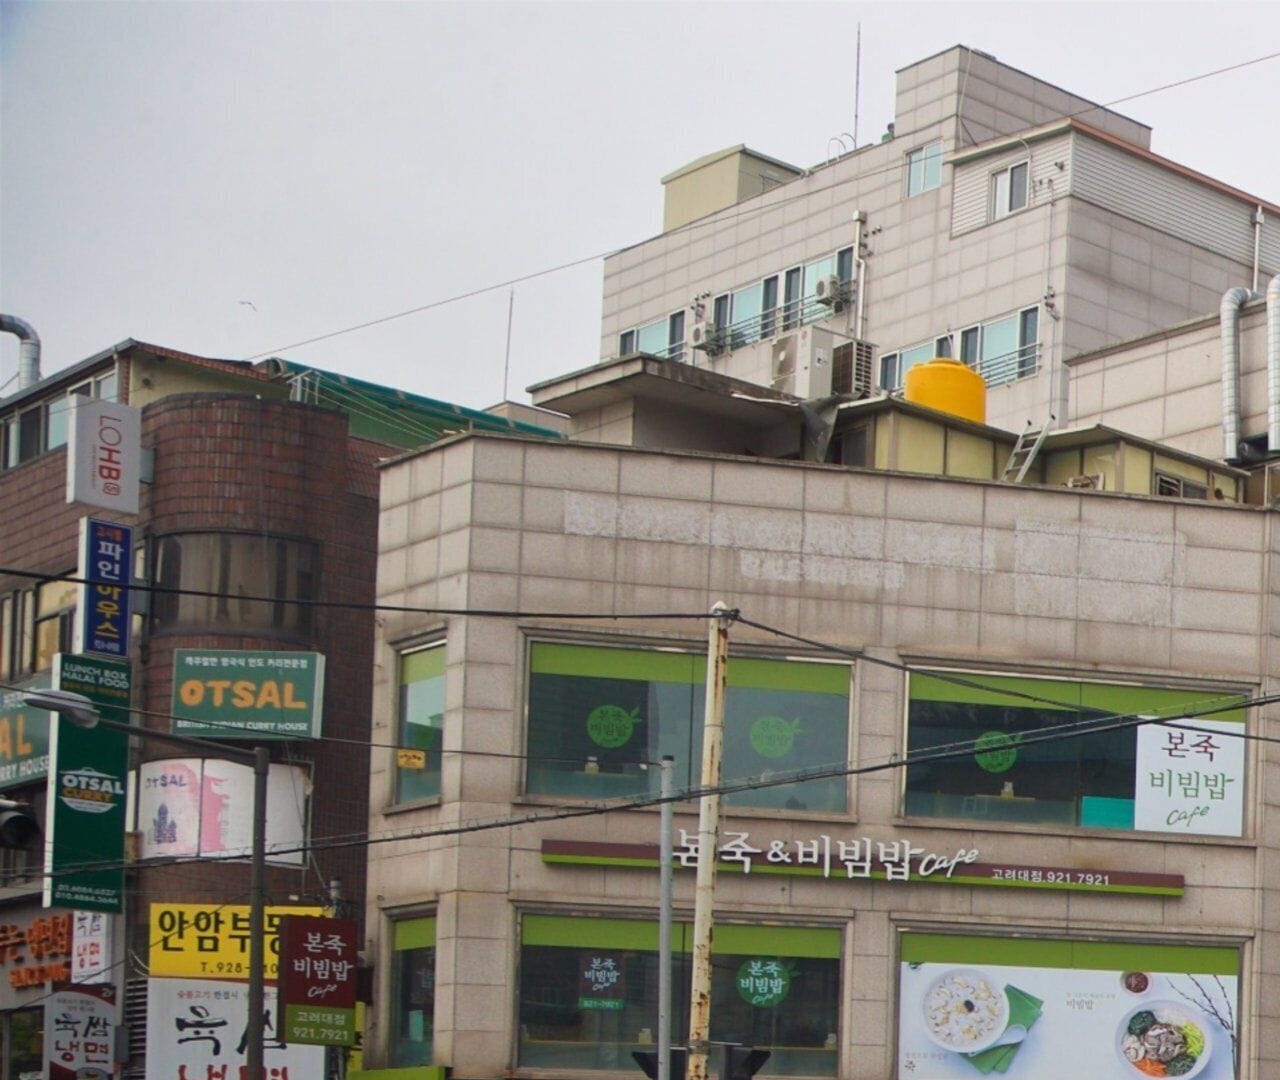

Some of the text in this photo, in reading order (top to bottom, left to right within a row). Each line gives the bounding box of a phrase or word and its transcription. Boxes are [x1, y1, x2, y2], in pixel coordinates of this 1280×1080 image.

[62, 670, 130, 689] HALAL FOOD
[64, 661, 128, 681] LUNCH BOX
[180, 679, 307, 709] OTSAL
[1162, 732, 1221, 762] 본죽
[62, 774, 125, 795] OTSAL
[1149, 769, 1235, 801] 비빔밥
[303, 931, 348, 956] 본죽
[294, 957, 354, 982] 비빔밥
[590, 957, 616, 970] 본죽
[747, 960, 781, 976] 본죽
[584, 969, 621, 984] 비빔밥
[740, 977, 787, 995] 비빔밥
[296, 1011, 346, 1026] 고려대점
[292, 1028, 348, 1041] 921.7921
[54, 1040, 109, 1064] 냉면
